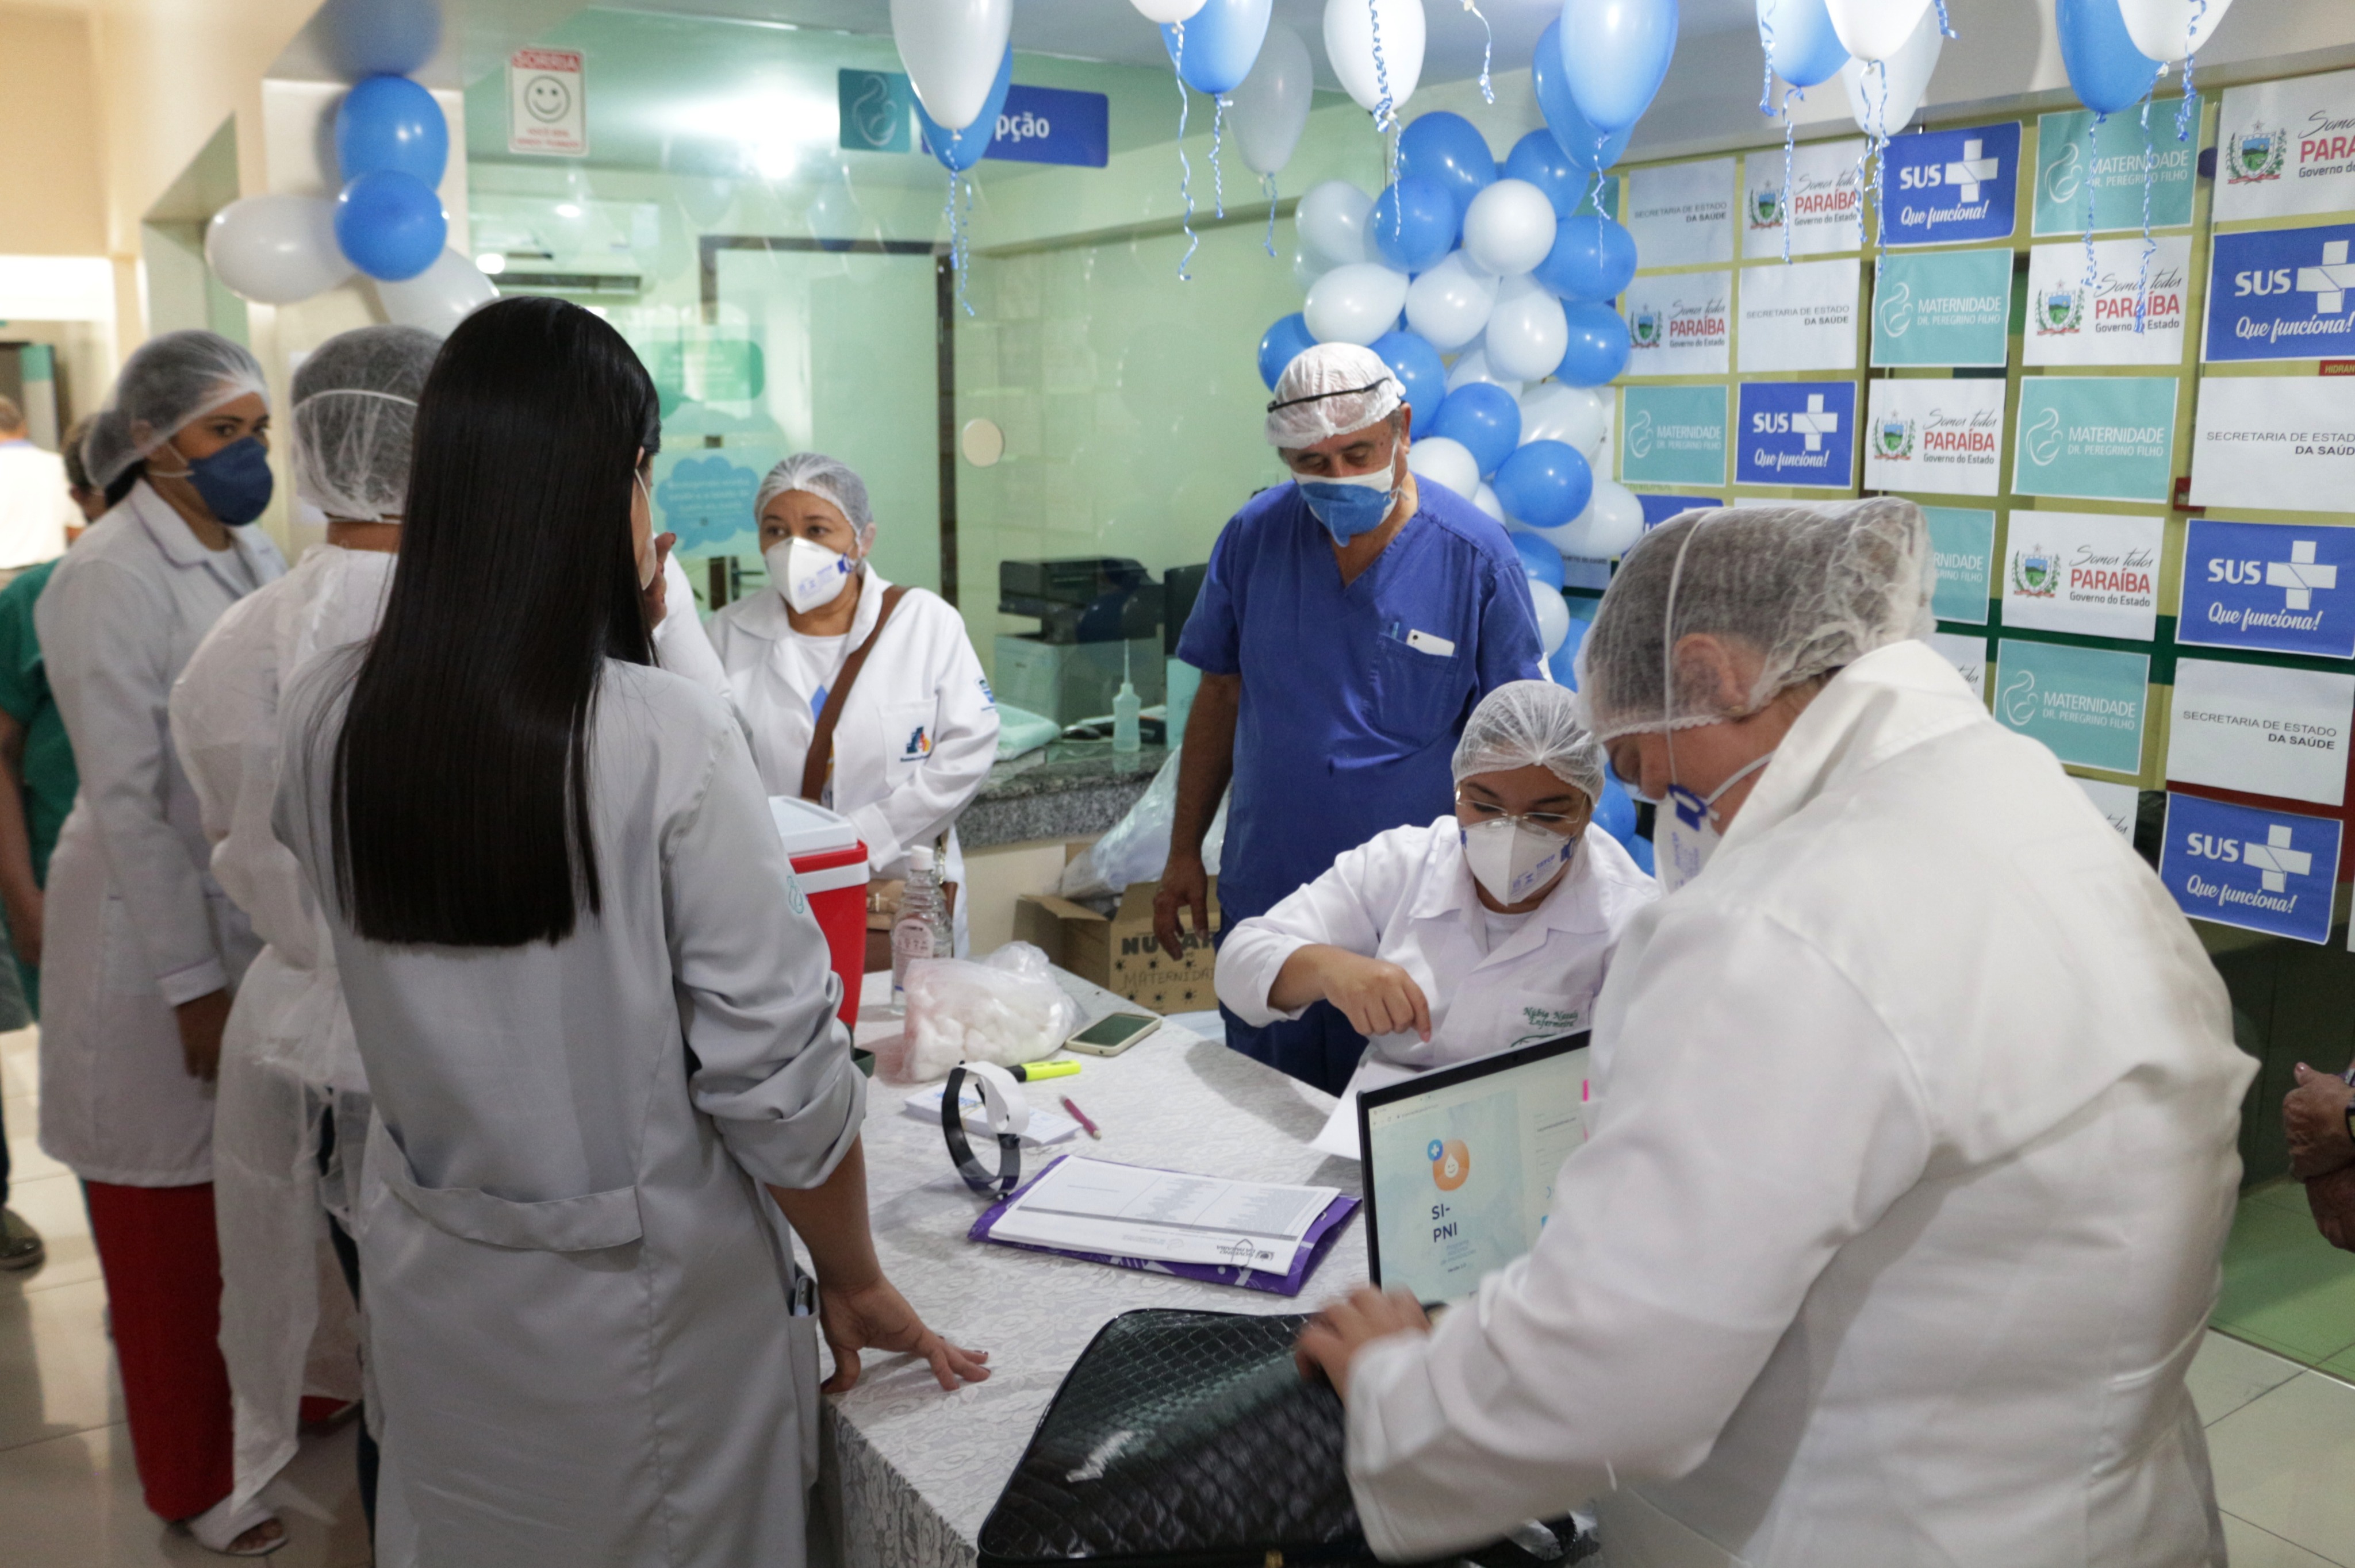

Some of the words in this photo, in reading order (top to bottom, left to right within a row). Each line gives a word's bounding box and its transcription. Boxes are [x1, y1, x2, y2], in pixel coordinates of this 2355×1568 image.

[995, 112, 1050, 141] pção
[2298, 110, 2355, 139] Somo
[2300, 135, 2355, 163] PARA
[2089, 149, 2189, 174] MATERNDADE
[2299, 166, 2344, 178] Governo
[1793, 174, 1832, 195] Somos
[1835, 164, 1859, 187] todo
[1900, 164, 1942, 190] SUS
[2106, 172, 2158, 187] PEREGRIO
[2161, 170, 2188, 182] FILHO
[1635, 207, 1681, 219] SECRETARIA
[1684, 206, 1694, 214] DE
[1695, 202, 1727, 213] ESTADO
[1794, 189, 1858, 215] PARAÍBA
[1686, 213, 1698, 223] DA
[1794, 216, 1823, 226] Governo
[1824, 214, 1832, 224] do
[1834, 212, 1858, 223] Estado
[1901, 205, 1927, 226] Que
[1927, 200, 1990, 229] funciona!
[2093, 272, 2142, 298] Somo
[2150, 266, 2183, 289] todos
[2235, 268, 2291, 297] SUS
[1669, 299, 1701, 320] Somos
[1704, 296, 1725, 315] todos
[1747, 308, 1798, 319] SECRETARIA
[1800, 307, 1811, 316] DE
[1815, 305, 1850, 315] ESTADO
[1917, 296, 2001, 314] MATERNIDADE
[1669, 316, 1725, 337] PARAÍBA
[1805, 317, 1817, 326] DA
[1819, 315, 1850, 325] SAÚDE
[1917, 316, 1930, 326] DR.
[1931, 314, 1976, 326] PEREGRINO
[1978, 313, 2000, 325] FILHO
[2095, 322, 2132, 333] Governo
[2147, 318, 2180, 330] Estado
[2236, 316, 2270, 340] Que
[2270, 311, 2355, 343] funciona!
[1669, 340, 1694, 348] Governo
[1696, 339, 1702, 347] do
[1704, 338, 1725, 347] Estado
[2325, 364, 2355, 374] HIDRAN
[1753, 412, 1789, 433] SUS
[1923, 408, 1966, 430] Somos
[1971, 408, 1997, 428] todos
[1657, 425, 1722, 439] MATERNIDADE
[1924, 429, 1995, 452] PARAÍBA
[2069, 426, 2165, 444] MATERNIDADE
[2207, 431, 2287, 442] SECRETARIA
[2290, 432, 2308, 442] DE
[2312, 433, 2355, 443] ESTAD
[1704, 441, 1721, 450] FILHO
[2068, 444, 2082, 455] DR.
[2084, 444, 2134, 456] PEREGRINO
[2137, 445, 2164, 457] FILHO
[2295, 446, 2314, 455] DA
[2318, 444, 2355, 456] SAÚD
[1754, 448, 1776, 467] Que
[1776, 449, 1829, 472] funciona!
[1923, 453, 1955, 464] Governo
[1957, 454, 1965, 463] do
[1967, 455, 1995, 464] Estado
[1934, 552, 1984, 570] RNIDADE
[2069, 544, 2118, 568] Somos
[2124, 547, 2154, 568] todos
[1961, 571, 1982, 583] FILHO
[2070, 567, 2150, 594] PARAÍBA
[2207, 559, 2262, 585] SUS
[2069, 592, 2105, 604] Governo
[2107, 593, 2118, 605] do
[2119, 595, 2150, 608] Estado
[2208, 602, 2242, 625] Que
[2241, 608, 2323, 632] funciona!
[2043, 691, 2137, 718] MATERNIDADE
[2043, 709, 2057, 721] DR.
[2059, 711, 2108, 728] PEREGRINO
[2109, 718, 2135, 731] FILHO
[2183, 710, 2260, 728] SECRETARIA
[2263, 720, 2280, 730] DE
[2284, 722, 2337, 737] ESTADO
[2268, 733, 2286, 744] DA
[2289, 736, 2335, 750] SAÚDE
[2187, 833, 2239, 863] SUS
[2187, 874, 2219, 898] Que
[2218, 884, 2299, 914] funciona!
[1432, 1203, 1450, 1220] SI-
[1433, 1222, 1458, 1243] PNI
